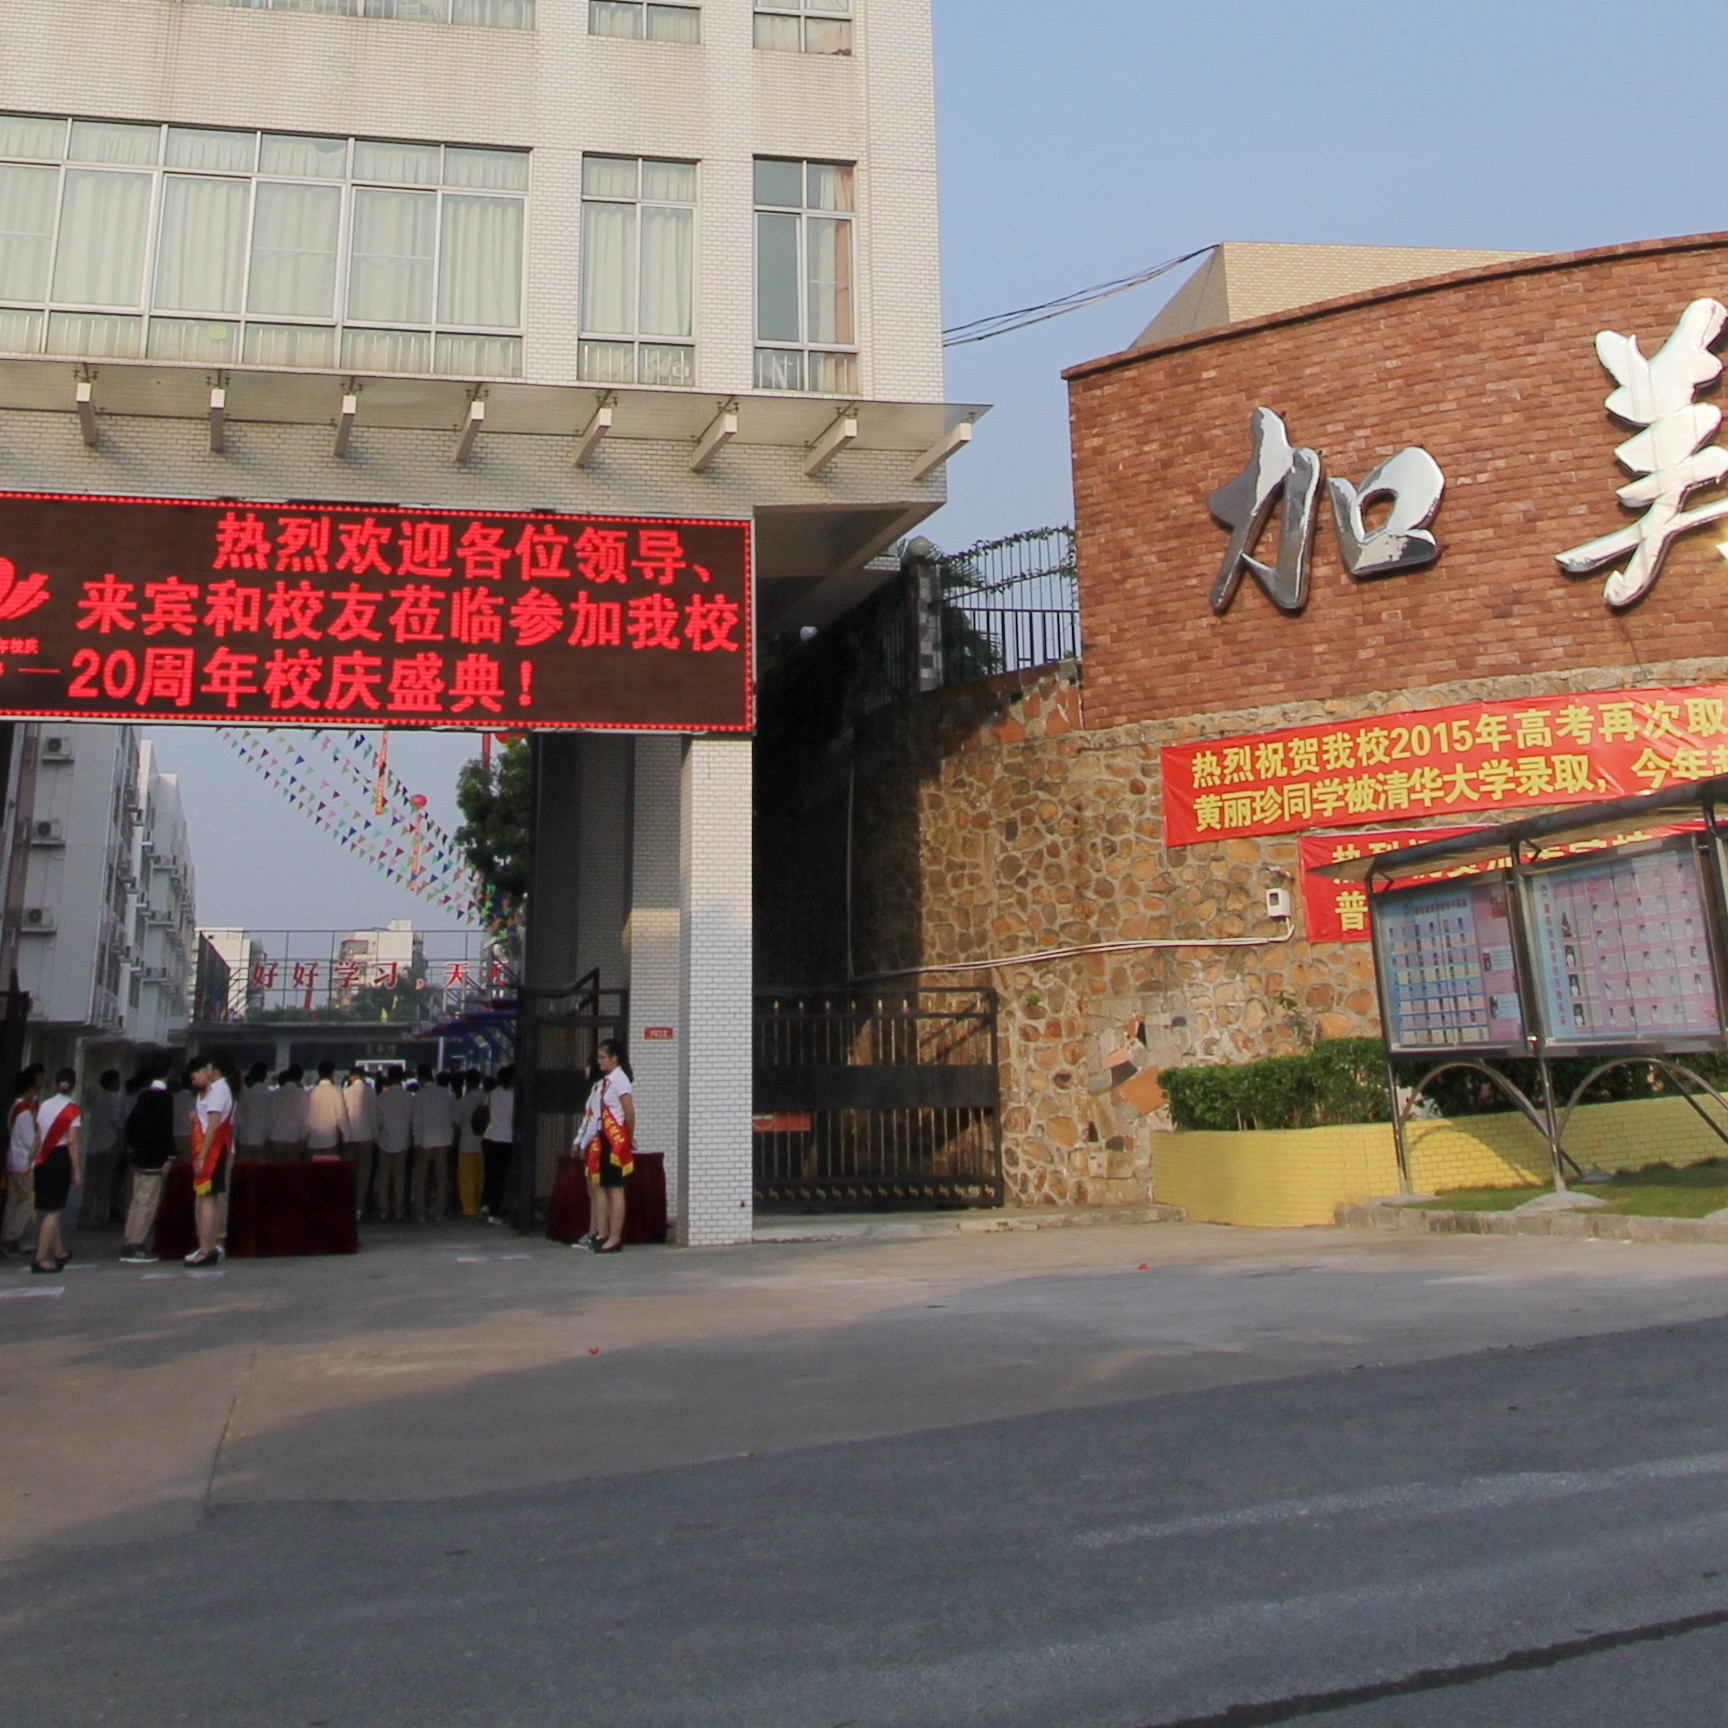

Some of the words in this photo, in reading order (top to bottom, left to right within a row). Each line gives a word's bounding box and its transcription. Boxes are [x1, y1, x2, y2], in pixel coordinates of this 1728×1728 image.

[212, 511, 713, 585] 热烈欢迎各位领导、
[77, 573, 740, 653] 来宾和校友莅临参加我校
[68, 647, 533, 713] 20周年校庆盛典！
